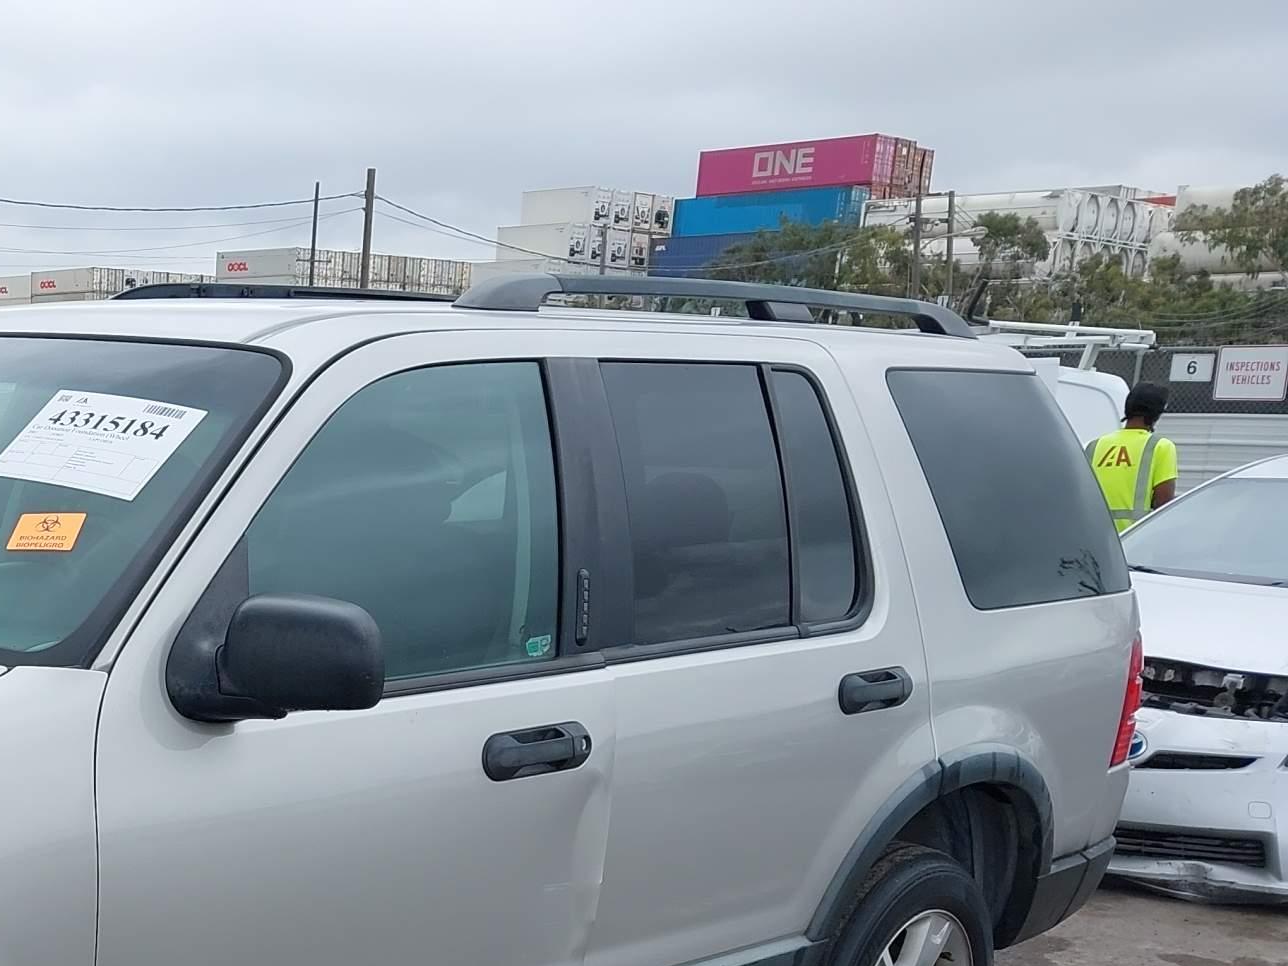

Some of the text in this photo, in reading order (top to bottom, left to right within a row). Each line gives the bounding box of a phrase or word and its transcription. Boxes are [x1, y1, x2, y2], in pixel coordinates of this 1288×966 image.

[752, 147, 815, 177] ONE
[227, 262, 249, 272] OOCL
[1186, 360, 1198, 375] 6
[1225, 361, 1281, 372] INSPECTIONS
[1231, 374, 1272, 385] VEHICLES
[48, 409, 170, 440] 43315184
